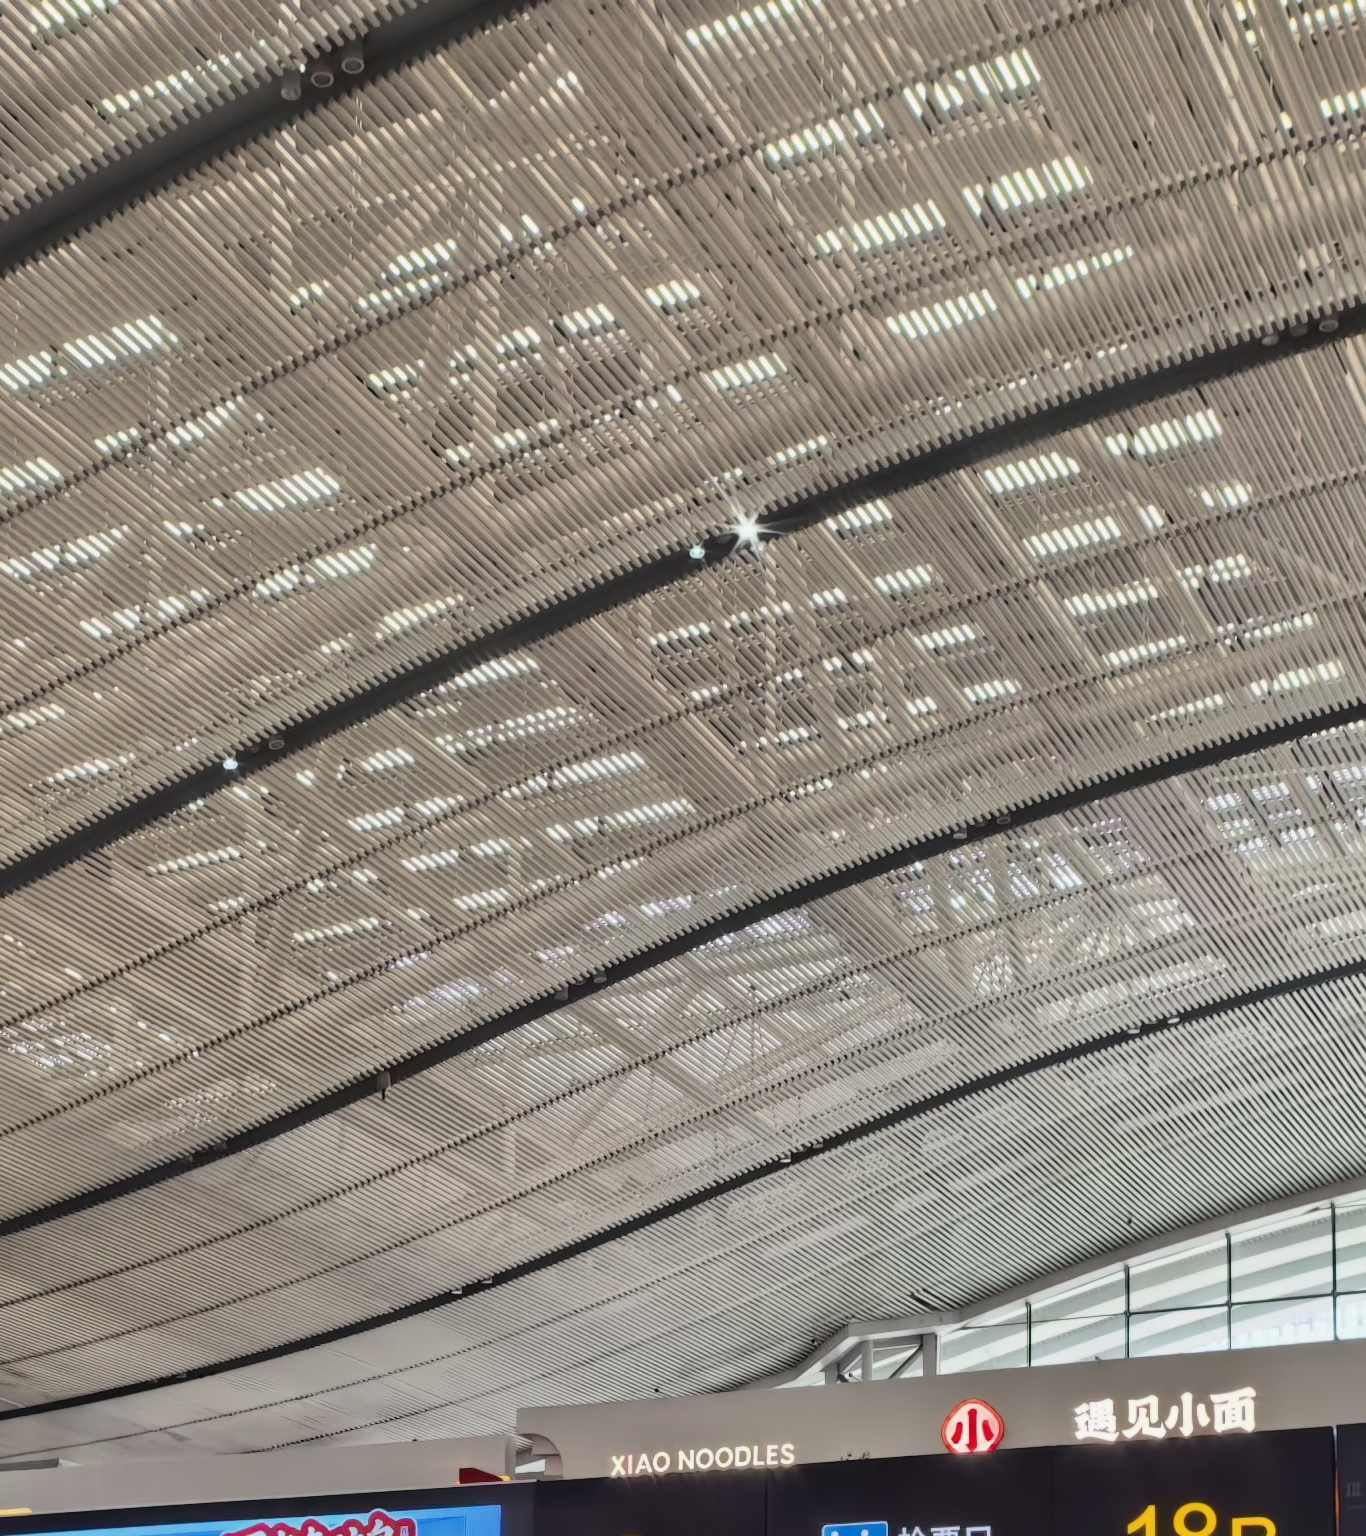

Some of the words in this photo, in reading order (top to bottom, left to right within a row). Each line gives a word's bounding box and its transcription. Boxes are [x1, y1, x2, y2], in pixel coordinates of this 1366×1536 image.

[1074, 1387, 1256, 1441] 遇见小面
[611, 1452, 671, 1477] XIAO
[678, 1443, 795, 1471] NOODLES
